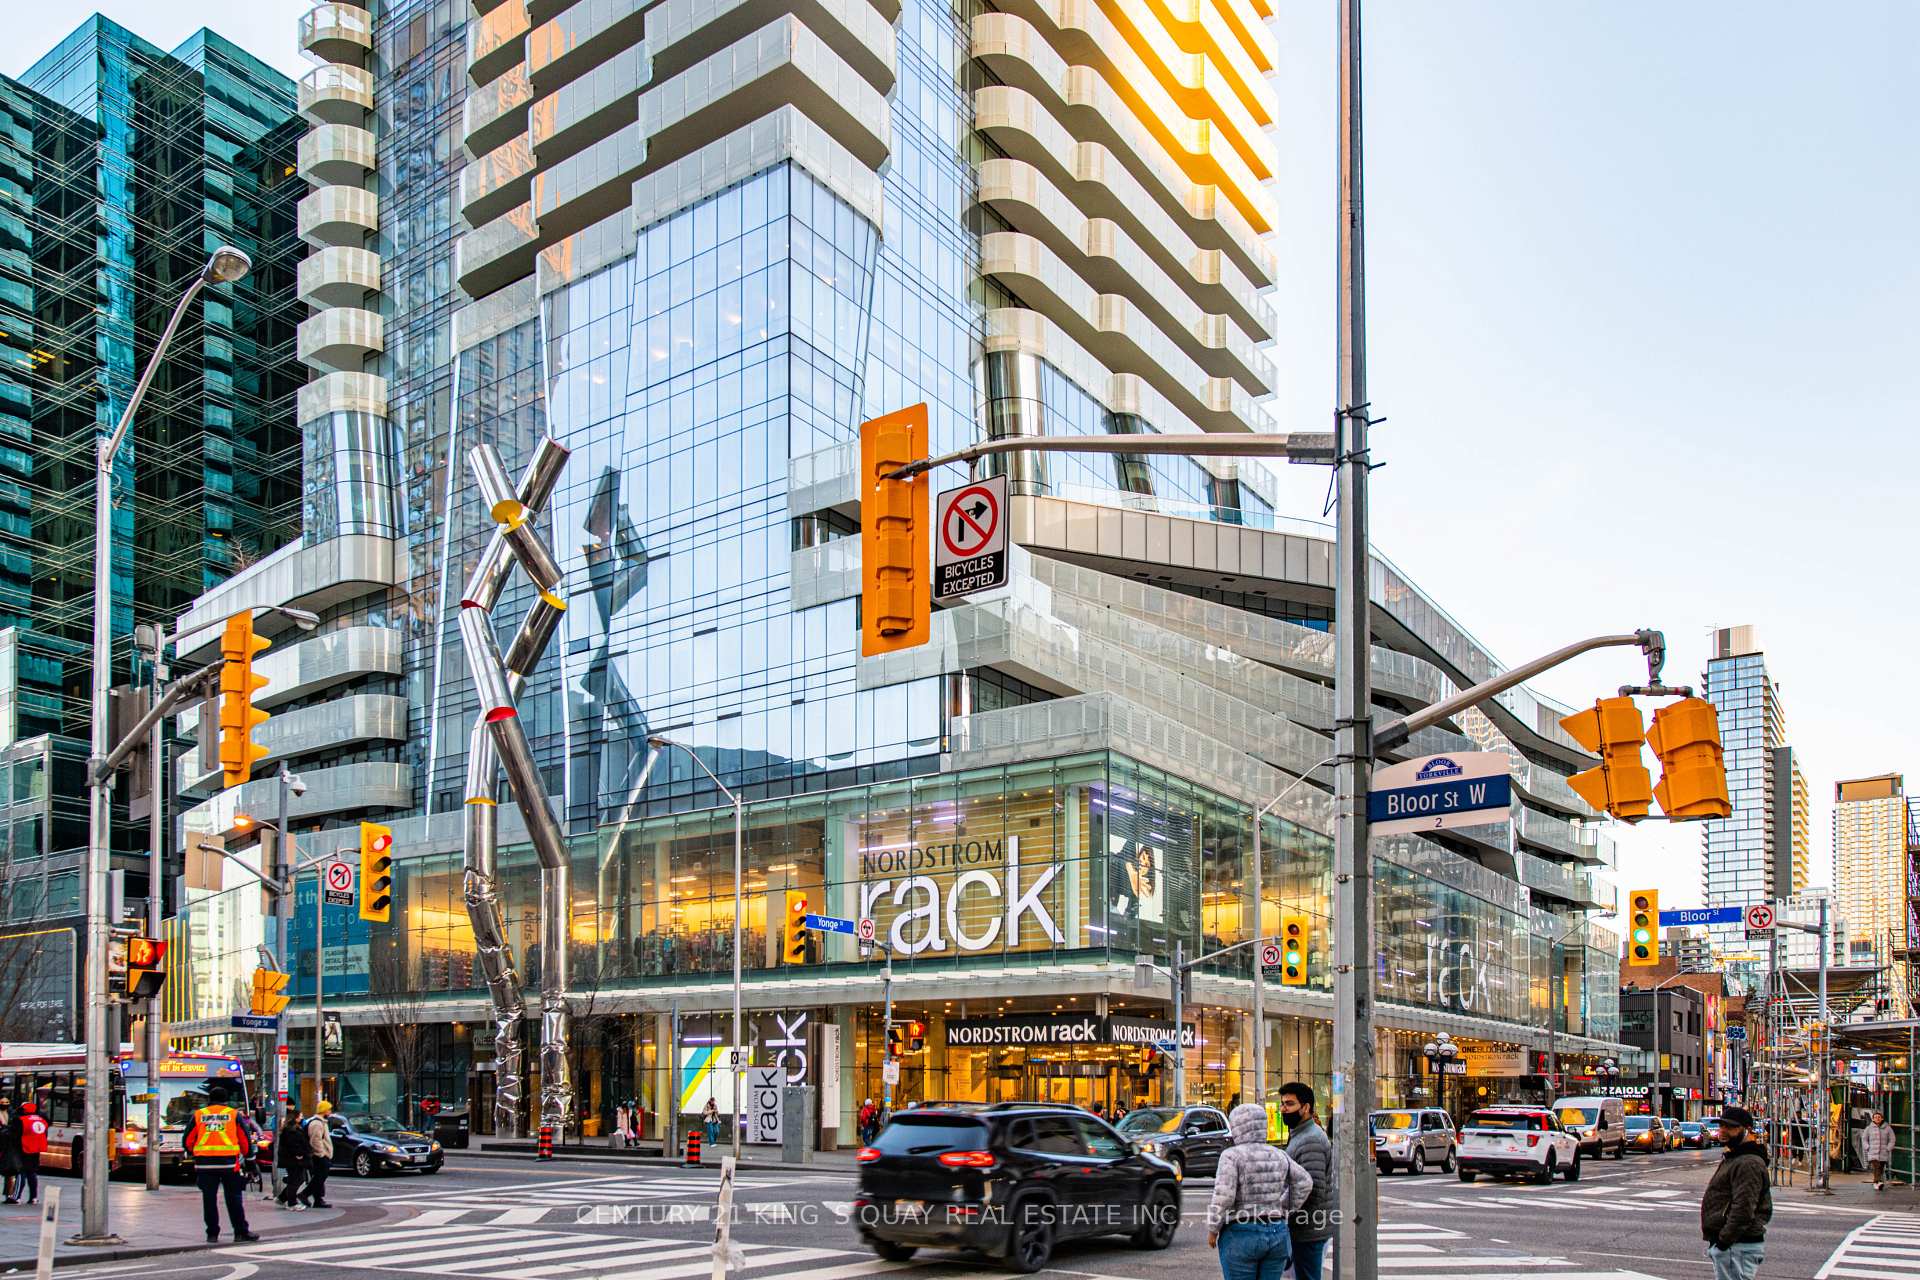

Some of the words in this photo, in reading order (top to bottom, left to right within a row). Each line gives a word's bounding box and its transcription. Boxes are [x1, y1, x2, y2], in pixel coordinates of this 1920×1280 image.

[945, 555, 994, 579] BICYCLES
[942, 571, 995, 595] EXCEPTED
[1419, 767, 1460, 779] YORKVILLE
[1427, 758, 1451, 769] BLOOR
[1387, 793, 1439, 815] Bloor
[1444, 791, 1459, 808] St
[1469, 783, 1486, 805] W
[1435, 817, 1443, 828] 2
[863, 839, 1003, 874] NORDSTROM
[861, 835, 1066, 956] rack
[817, 917, 838, 930] Yonge
[1680, 911, 1711, 922] Bloor
[949, 1025, 1047, 1044] NORDSTROM
[1051, 1018, 1097, 1042] rack
[1112, 1023, 1170, 1043] NORDSTROM
[1170, 1022, 1194, 1047] rck
[1591, 1086, 1648, 1095] IZZAIOLO
[754, 1069, 778, 1142] rack
